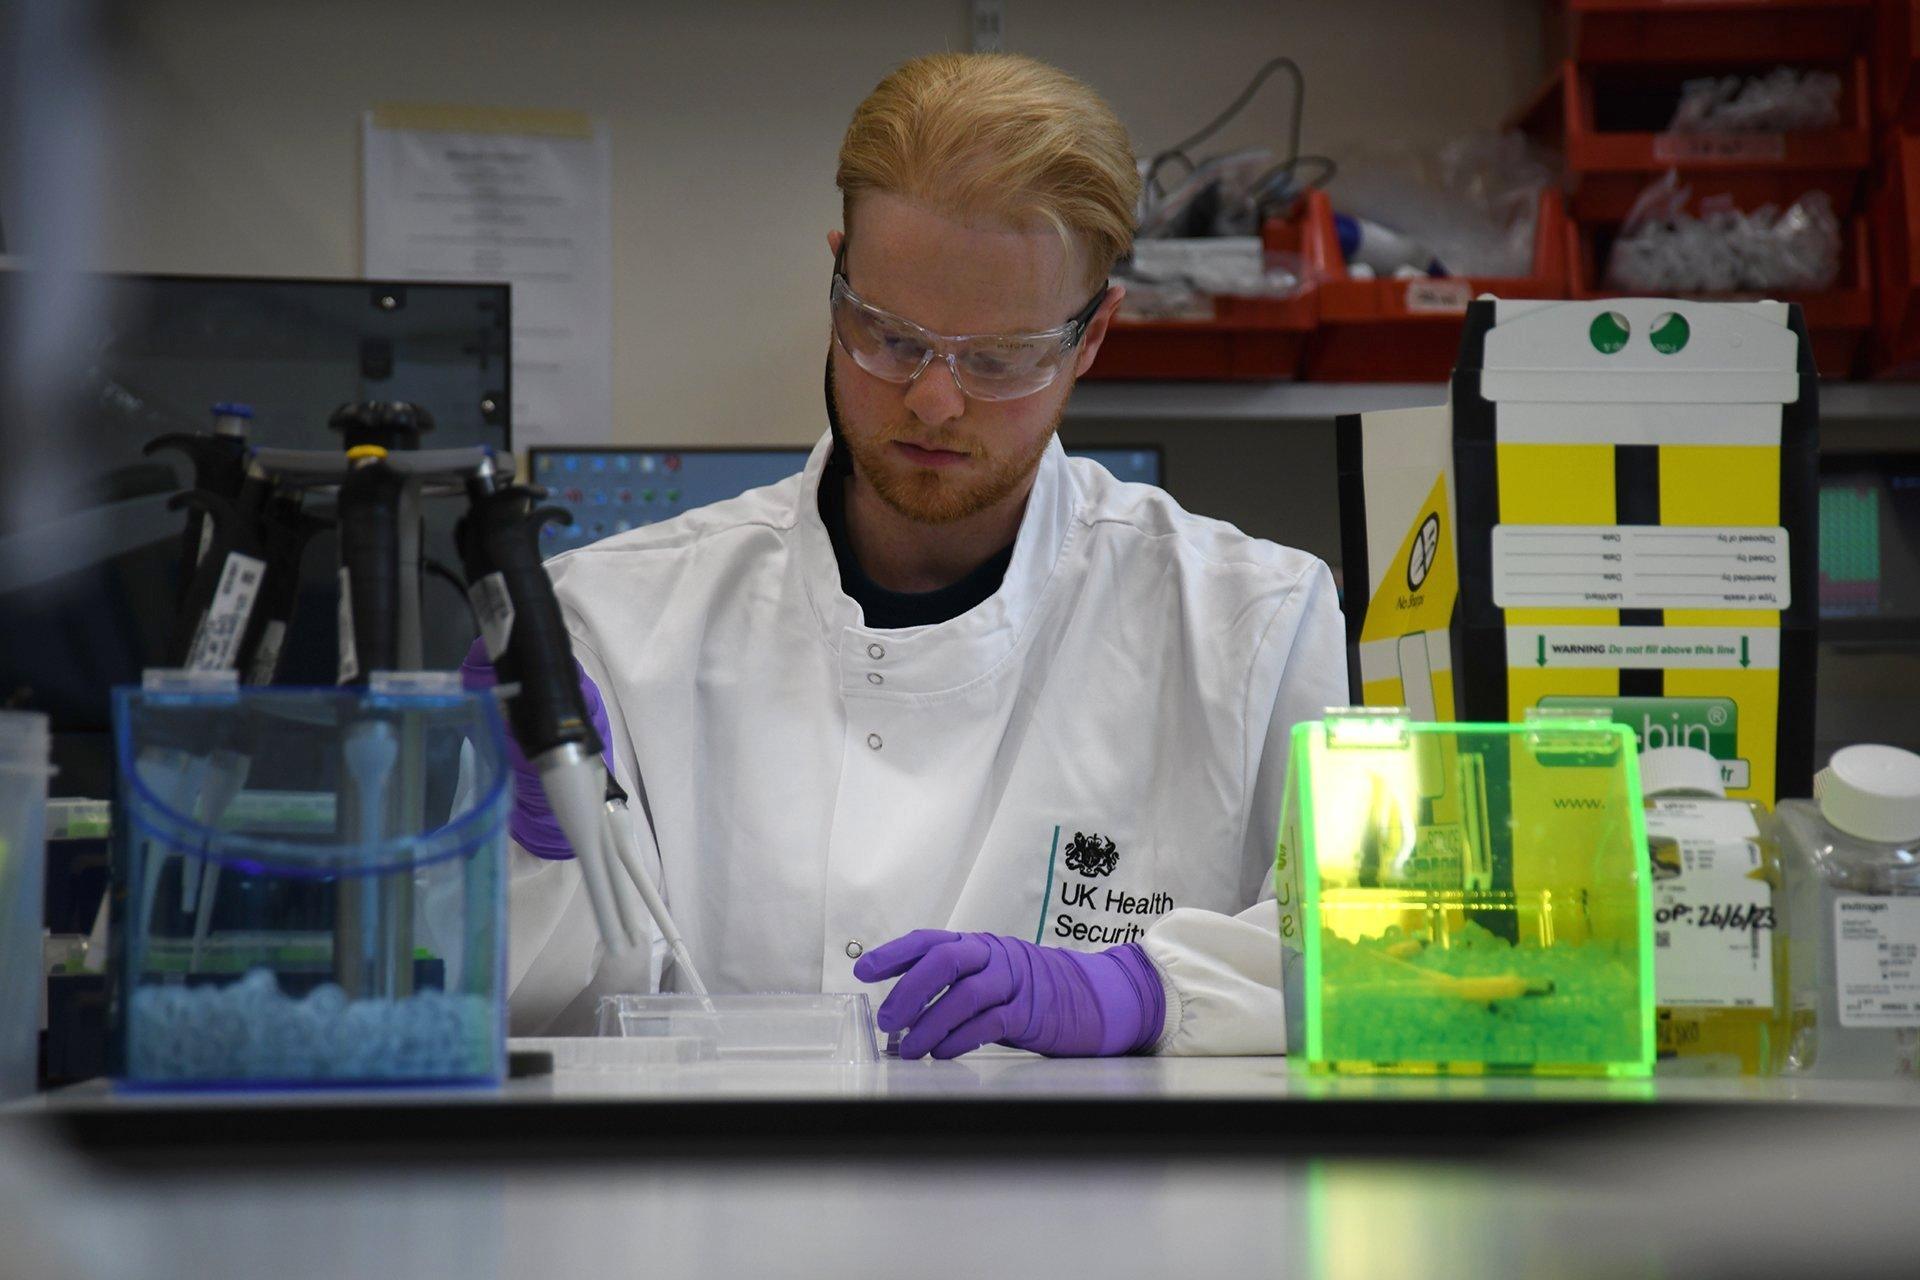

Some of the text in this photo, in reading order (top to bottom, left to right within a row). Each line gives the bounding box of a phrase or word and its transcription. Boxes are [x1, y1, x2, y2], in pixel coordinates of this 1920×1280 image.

[1602, 534, 1621, 542] Date
[1602, 553, 1622, 562] Date
[1748, 555, 1776, 563] Closed
[1603, 573, 1622, 582] Date
[1758, 593, 1777, 603] Type
[1551, 644, 1736, 655] WARNING Do not fill above this line
[1061, 882, 1175, 915] UK Health
[1698, 903, 1778, 931] 26/6/23
[1054, 914, 1147, 944] Securit
